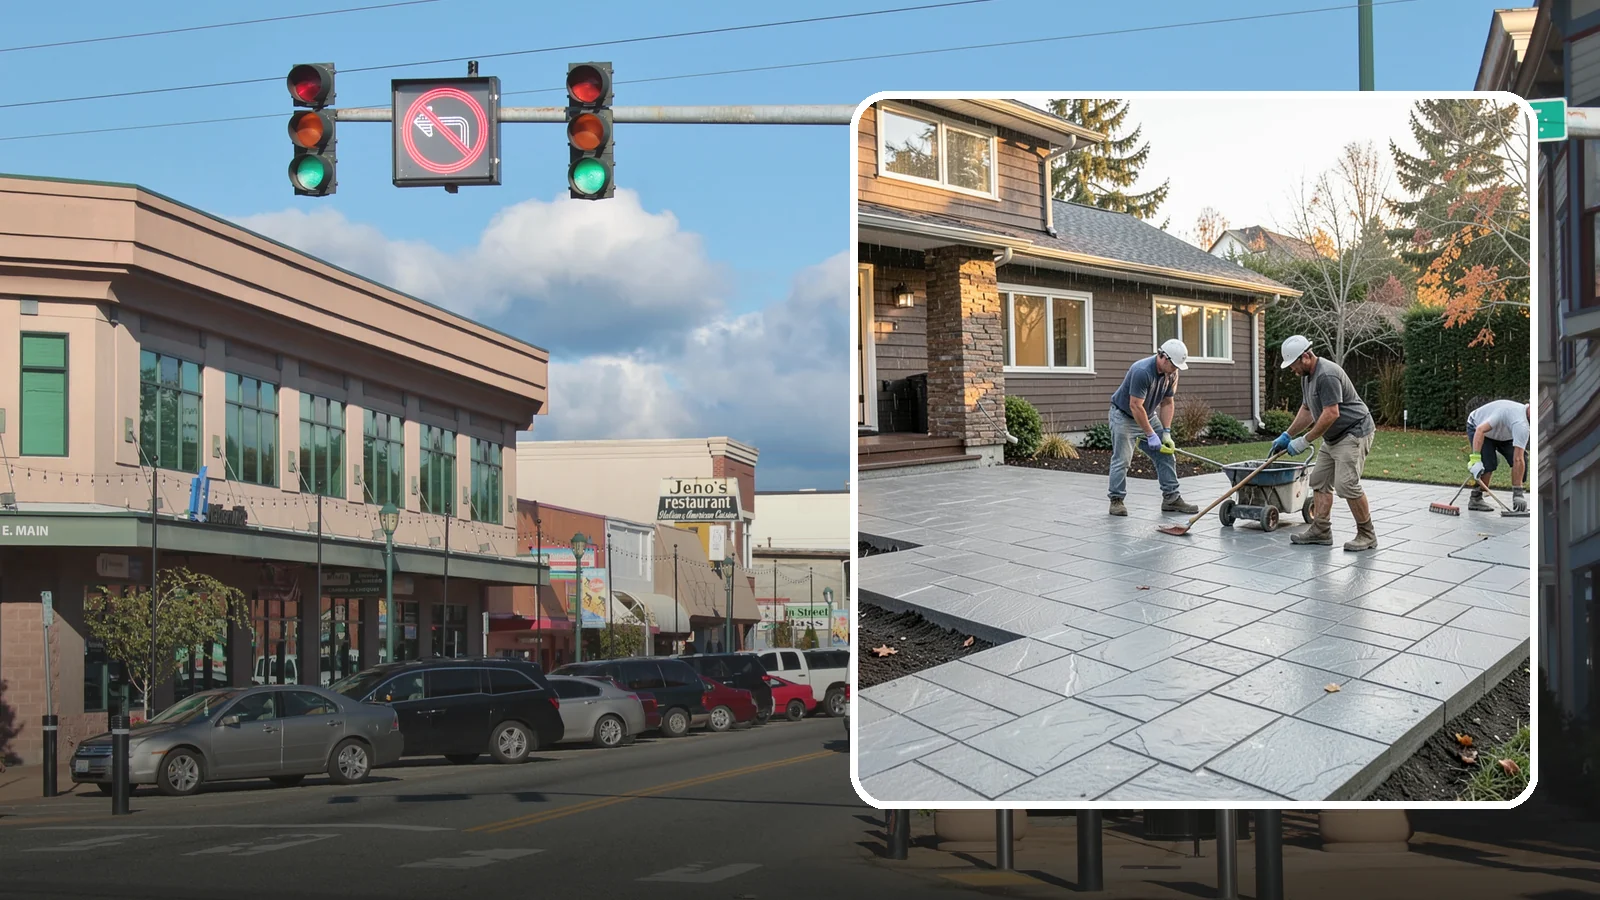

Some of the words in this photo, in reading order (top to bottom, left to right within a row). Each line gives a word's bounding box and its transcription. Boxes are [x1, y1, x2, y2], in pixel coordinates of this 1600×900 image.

[669, 480, 728, 494] Jeno's
[665, 496, 731, 509] restaurant
[658, 509, 681, 519] Italian
[686, 509, 714, 519] American
[715, 509, 738, 519] Cuisine
[2, 525, 13, 536] E.
[15, 525, 49, 536] MAIN
[785, 607, 795, 617] in
[797, 607, 828, 617] Street
[791, 619, 824, 627] lass
